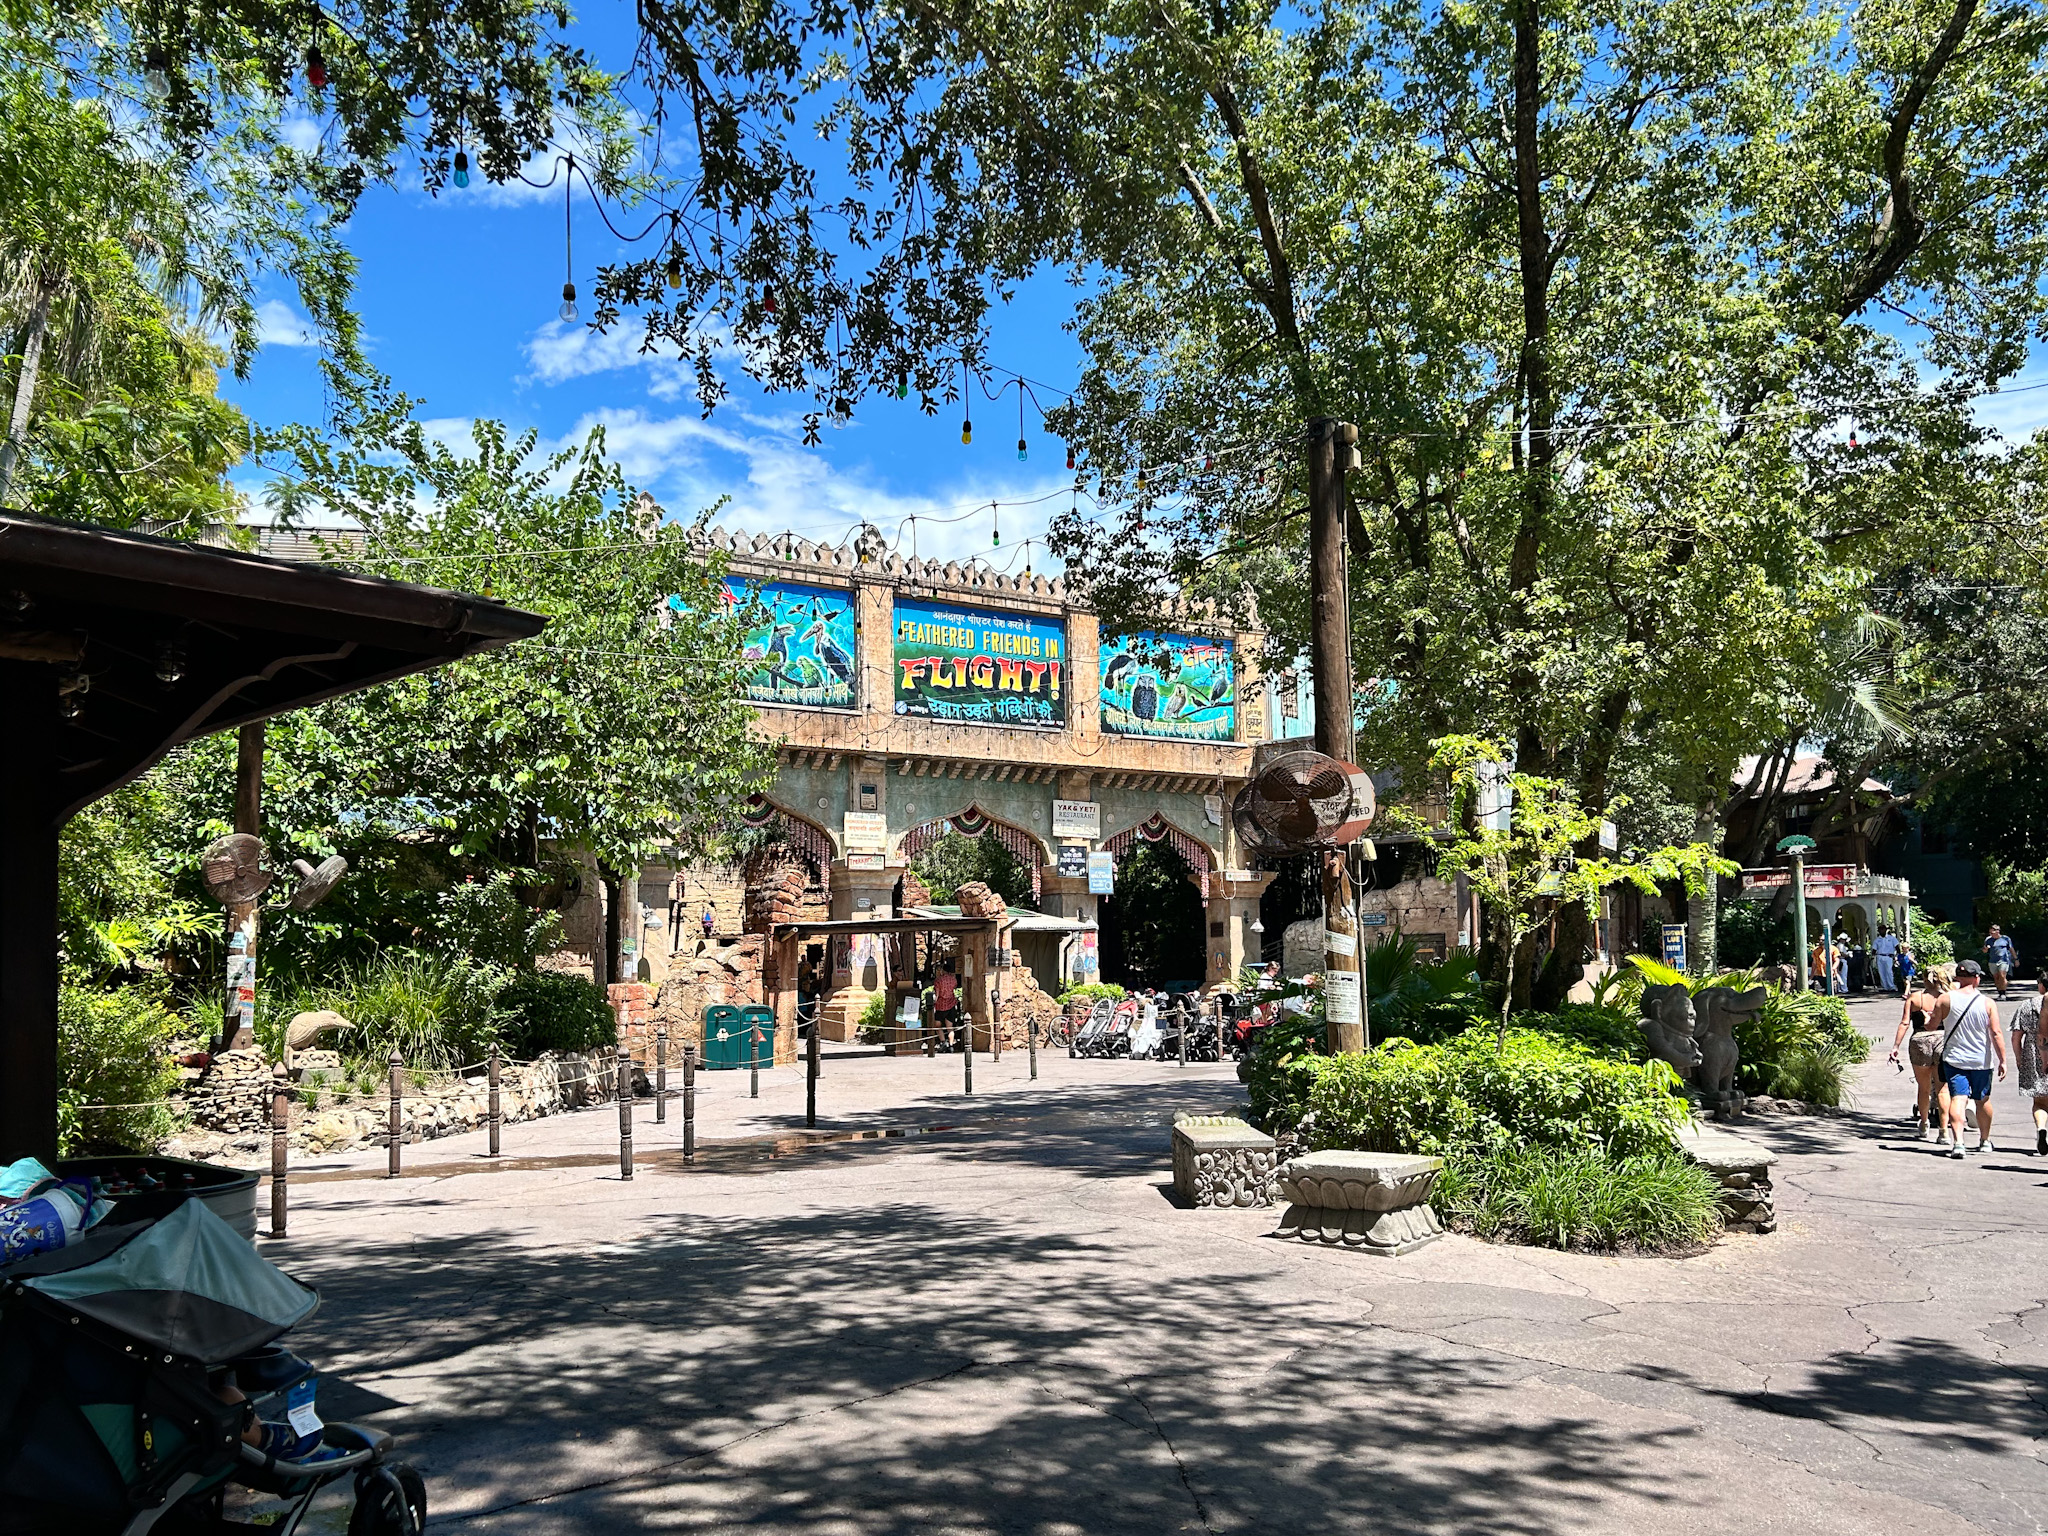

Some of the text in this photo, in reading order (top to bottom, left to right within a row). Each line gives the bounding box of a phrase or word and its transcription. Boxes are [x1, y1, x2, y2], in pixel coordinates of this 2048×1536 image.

[900, 620, 1059, 659] FEATHERED FRIENDS IN
[898, 655, 1060, 701] FLIGHT!
[1058, 812, 1095, 820] RESTAURANT
